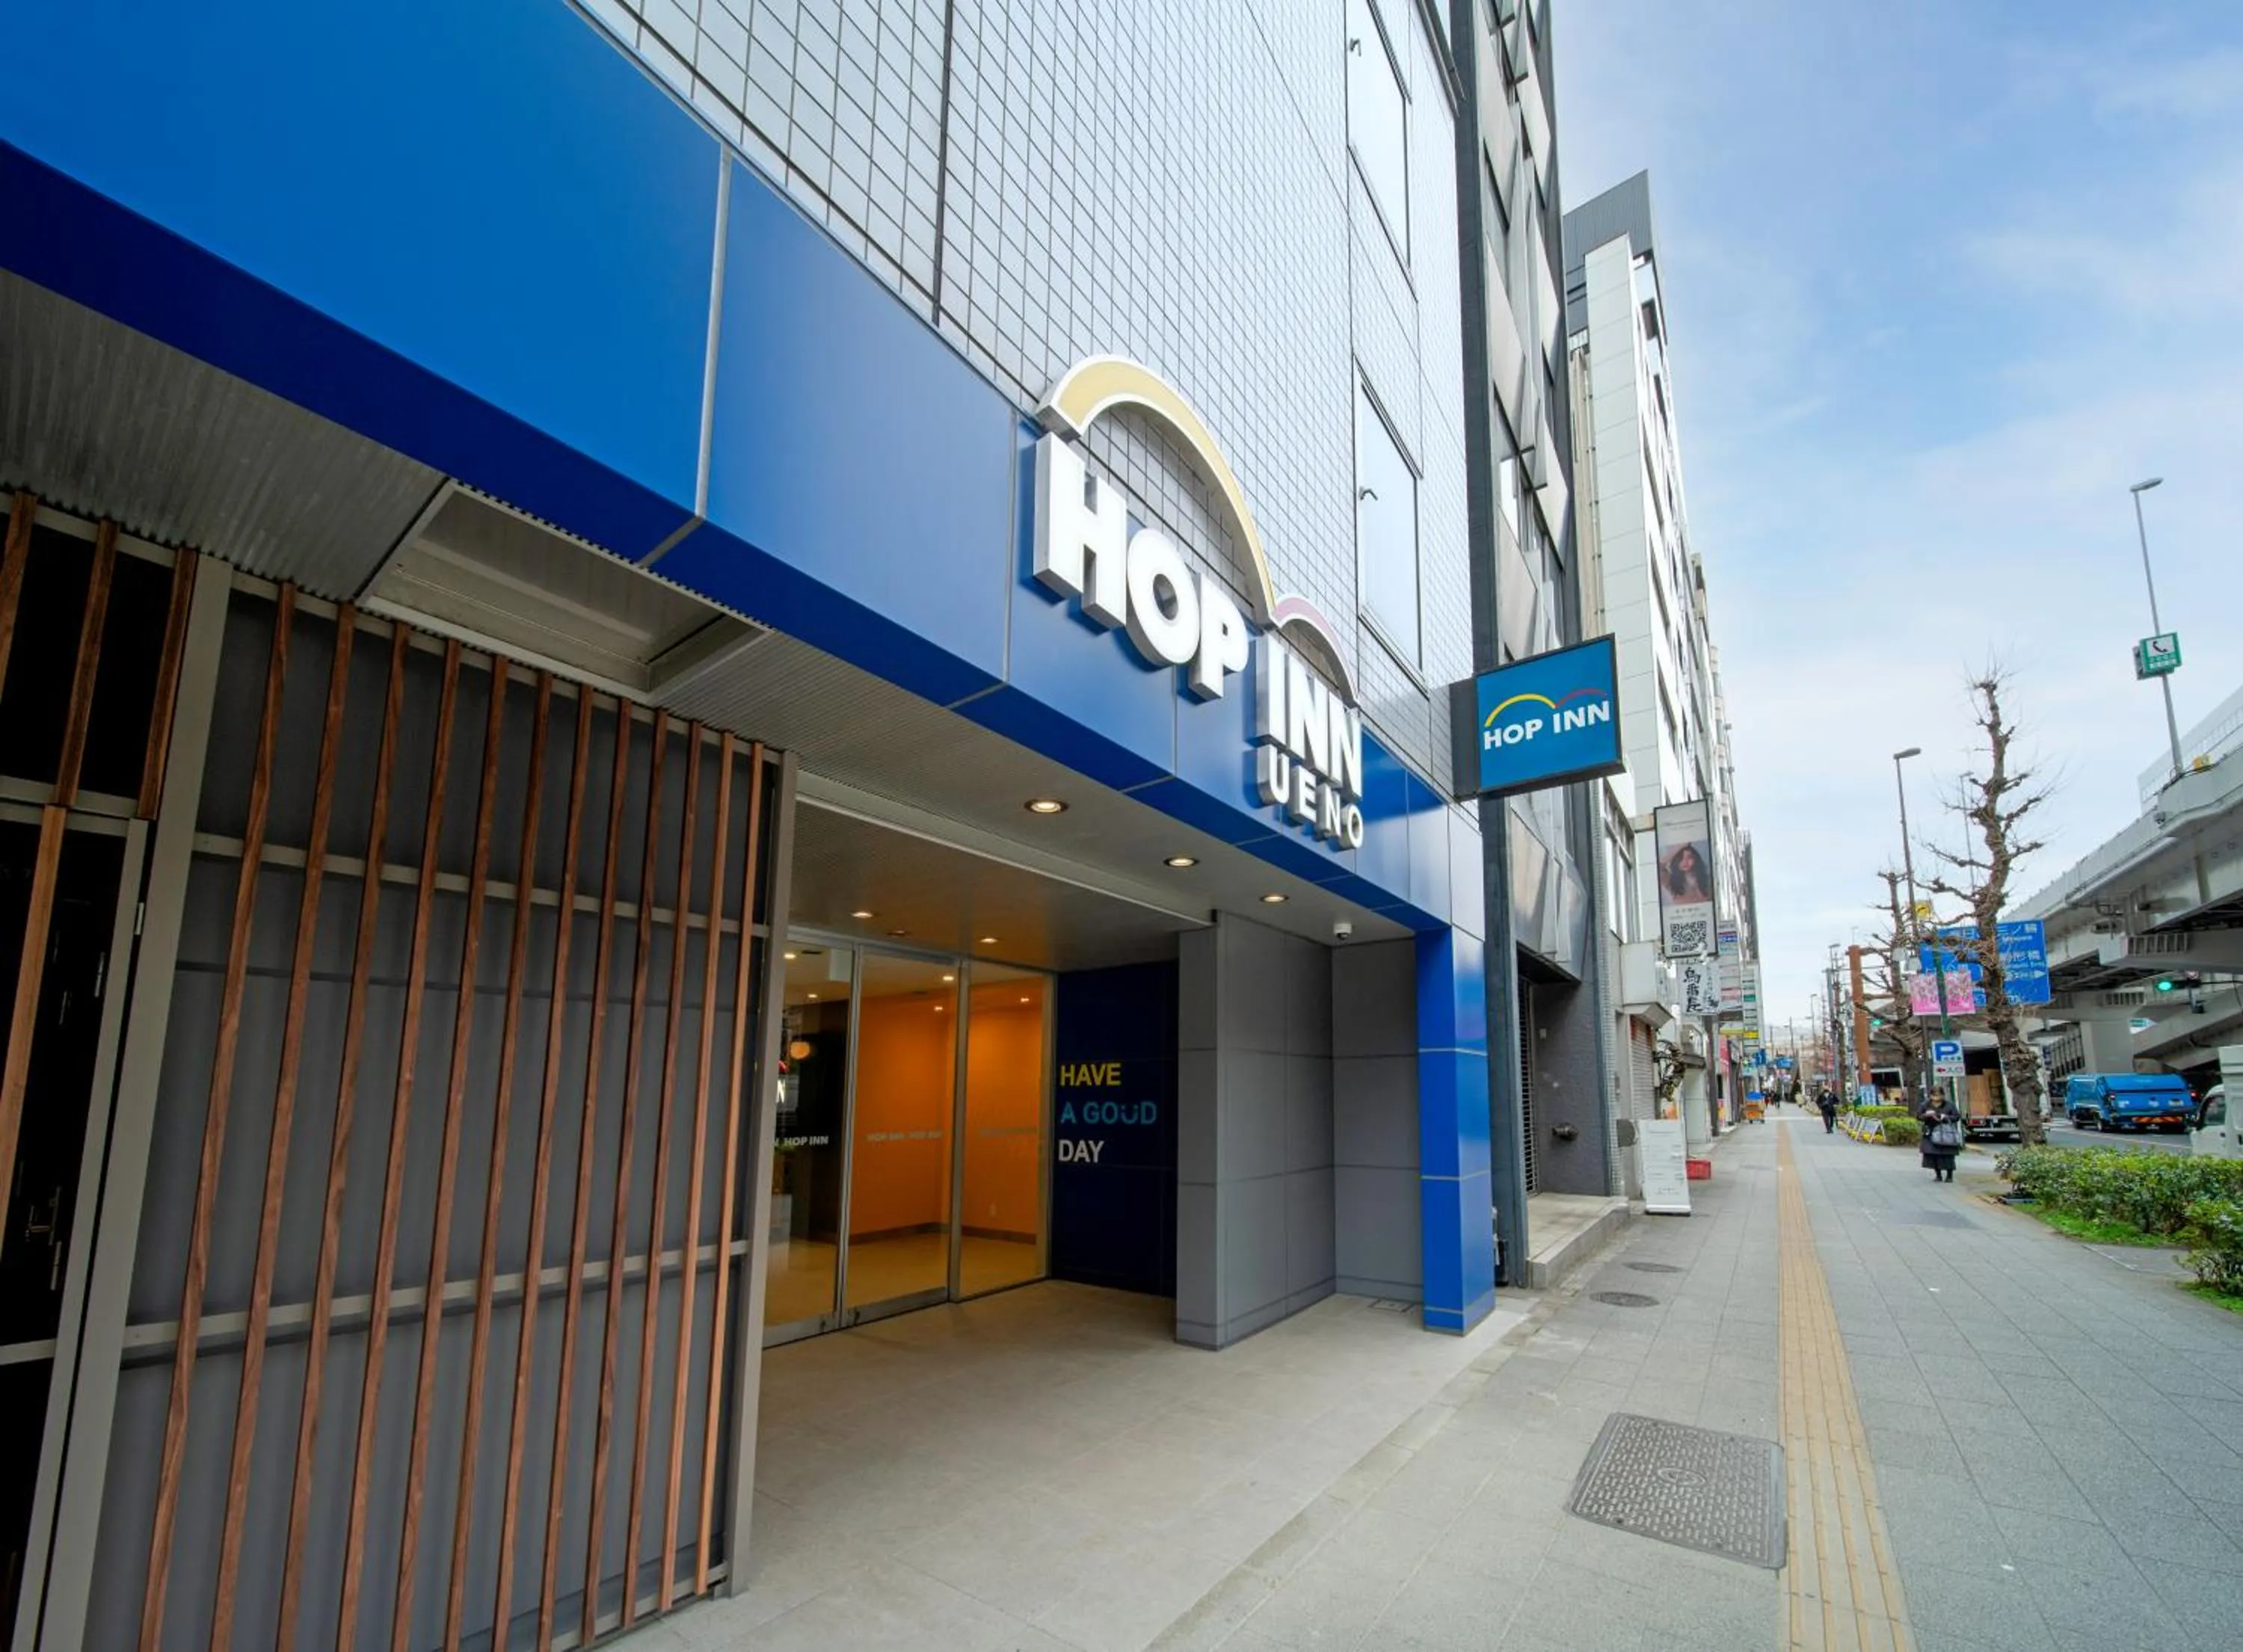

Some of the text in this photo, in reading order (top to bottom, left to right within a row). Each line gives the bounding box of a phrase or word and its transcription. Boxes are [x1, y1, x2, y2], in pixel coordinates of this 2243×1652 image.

[1033, 431, 1362, 799] HOP INN
[1483, 700, 1610, 750] HOP INN
[1258, 745, 1363, 848] UENO
[1935, 1043, 1960, 1061] P
[1060, 1062, 1122, 1086] HAVE
[1060, 1101, 1077, 1124] A
[784, 1136, 808, 1146] HOP
[810, 1135, 829, 1145] INN
[1058, 1138, 1105, 1163] DAY
